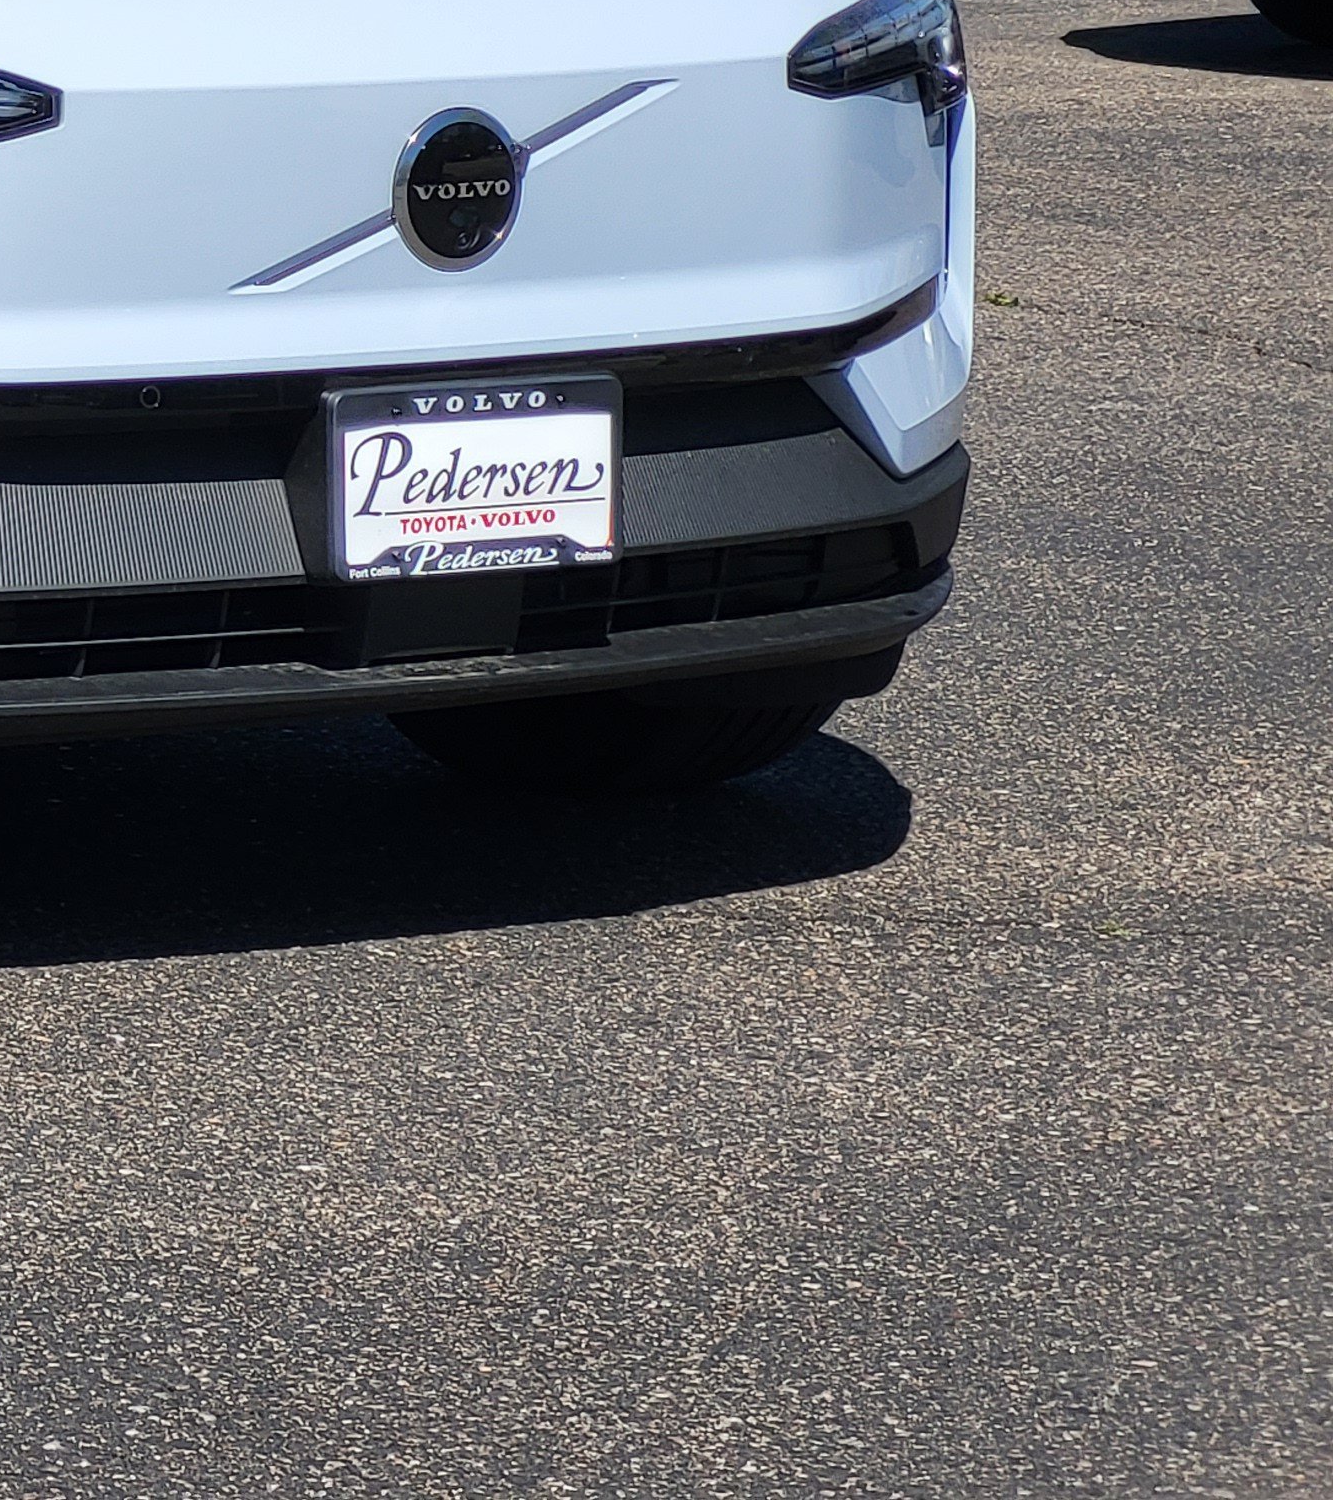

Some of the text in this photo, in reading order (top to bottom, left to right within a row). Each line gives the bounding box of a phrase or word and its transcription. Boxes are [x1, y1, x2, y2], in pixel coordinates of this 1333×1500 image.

[412, 179, 511, 201] VOLVO
[412, 390, 547, 415] VOLVO
[350, 431, 604, 518] Pedersen
[400, 509, 556, 535] TOYOTA VOLVO
[404, 541, 559, 576] Pedersen
